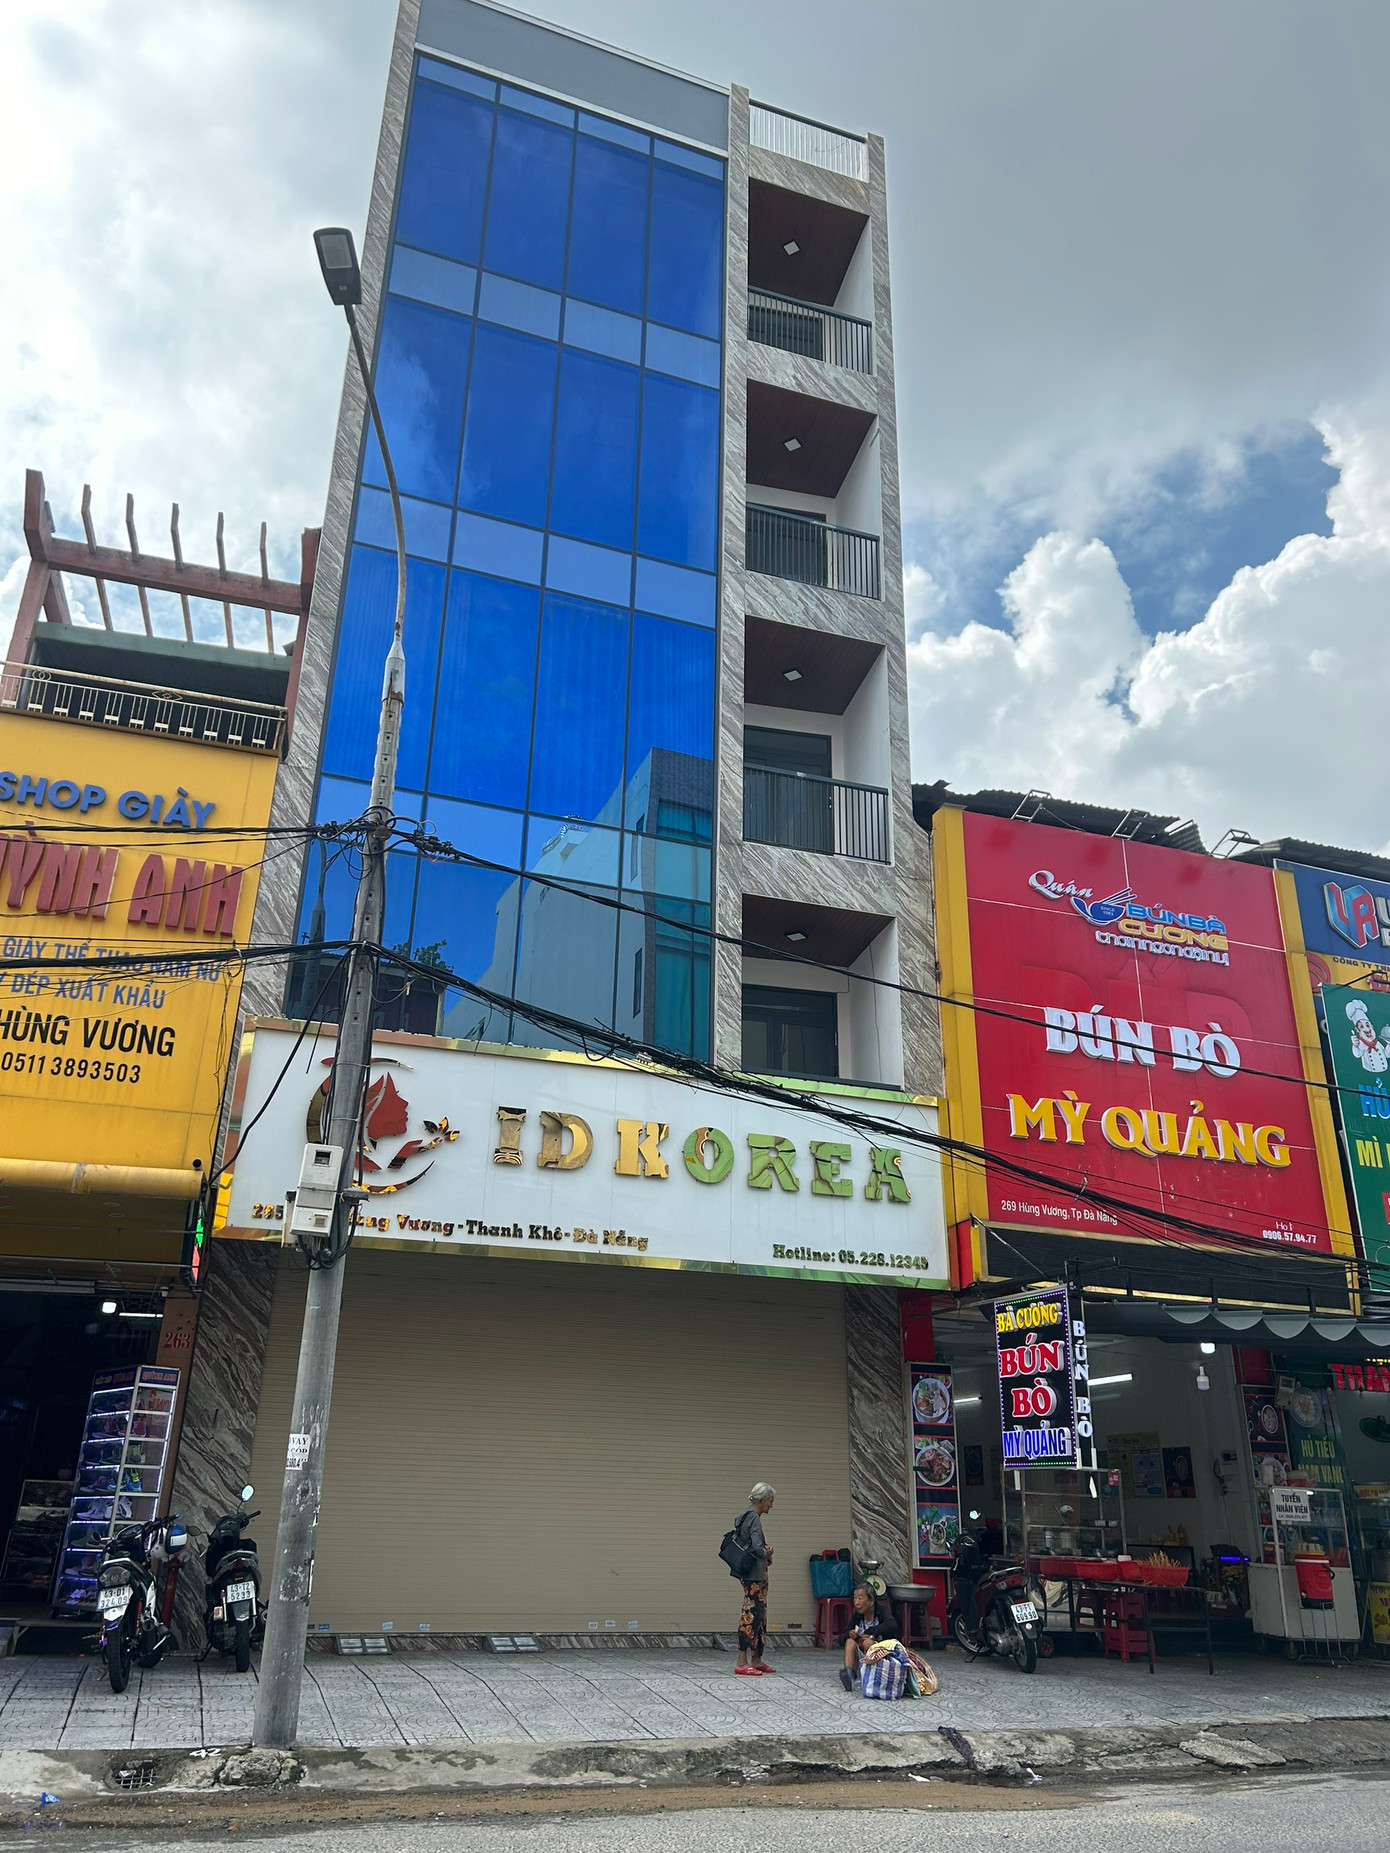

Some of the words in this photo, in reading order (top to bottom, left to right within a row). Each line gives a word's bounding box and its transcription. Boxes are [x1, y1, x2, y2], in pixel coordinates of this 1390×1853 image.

[0, 771, 106, 813] SHOP
[117, 787, 215, 829] GIÀY
[0, 821, 119, 920] ỲNH
[128, 853, 245, 937] ANH
[0, 1006, 70, 1046] HÙNG
[83, 1017, 176, 1057] VƯƠNG
[1043, 1005, 1156, 1067] BÚN
[1169, 1022, 1241, 1078] BÒ
[51, 1056, 141, 1084] 3893503
[1006, 1090, 1091, 1145] MỲ
[1101, 1100, 1291, 1168] QUẢNG
[1355, 1136, 1384, 1169] MÌ
[1001, 1200, 1016, 1212] 269
[1018, 1201, 1040, 1217] Hùng
[1071, 1208, 1082, 1221] Tp
[1083, 1210, 1095, 1221] Đà
[773, 1243, 836, 1263] Hotline:
[996, 1305, 1018, 1333] BÀ
[162, 1331, 191, 1349] 263
[999, 1332, 1065, 1378] BÚN
[1011, 1377, 1057, 1418] BÒ
[1003, 1425, 1024, 1459] MỲ
[1023, 1419, 1072, 1460] QUẢNG
[100, 1595, 128, 1609] 324.09
[230, 1590, 251, 1601] 5233
